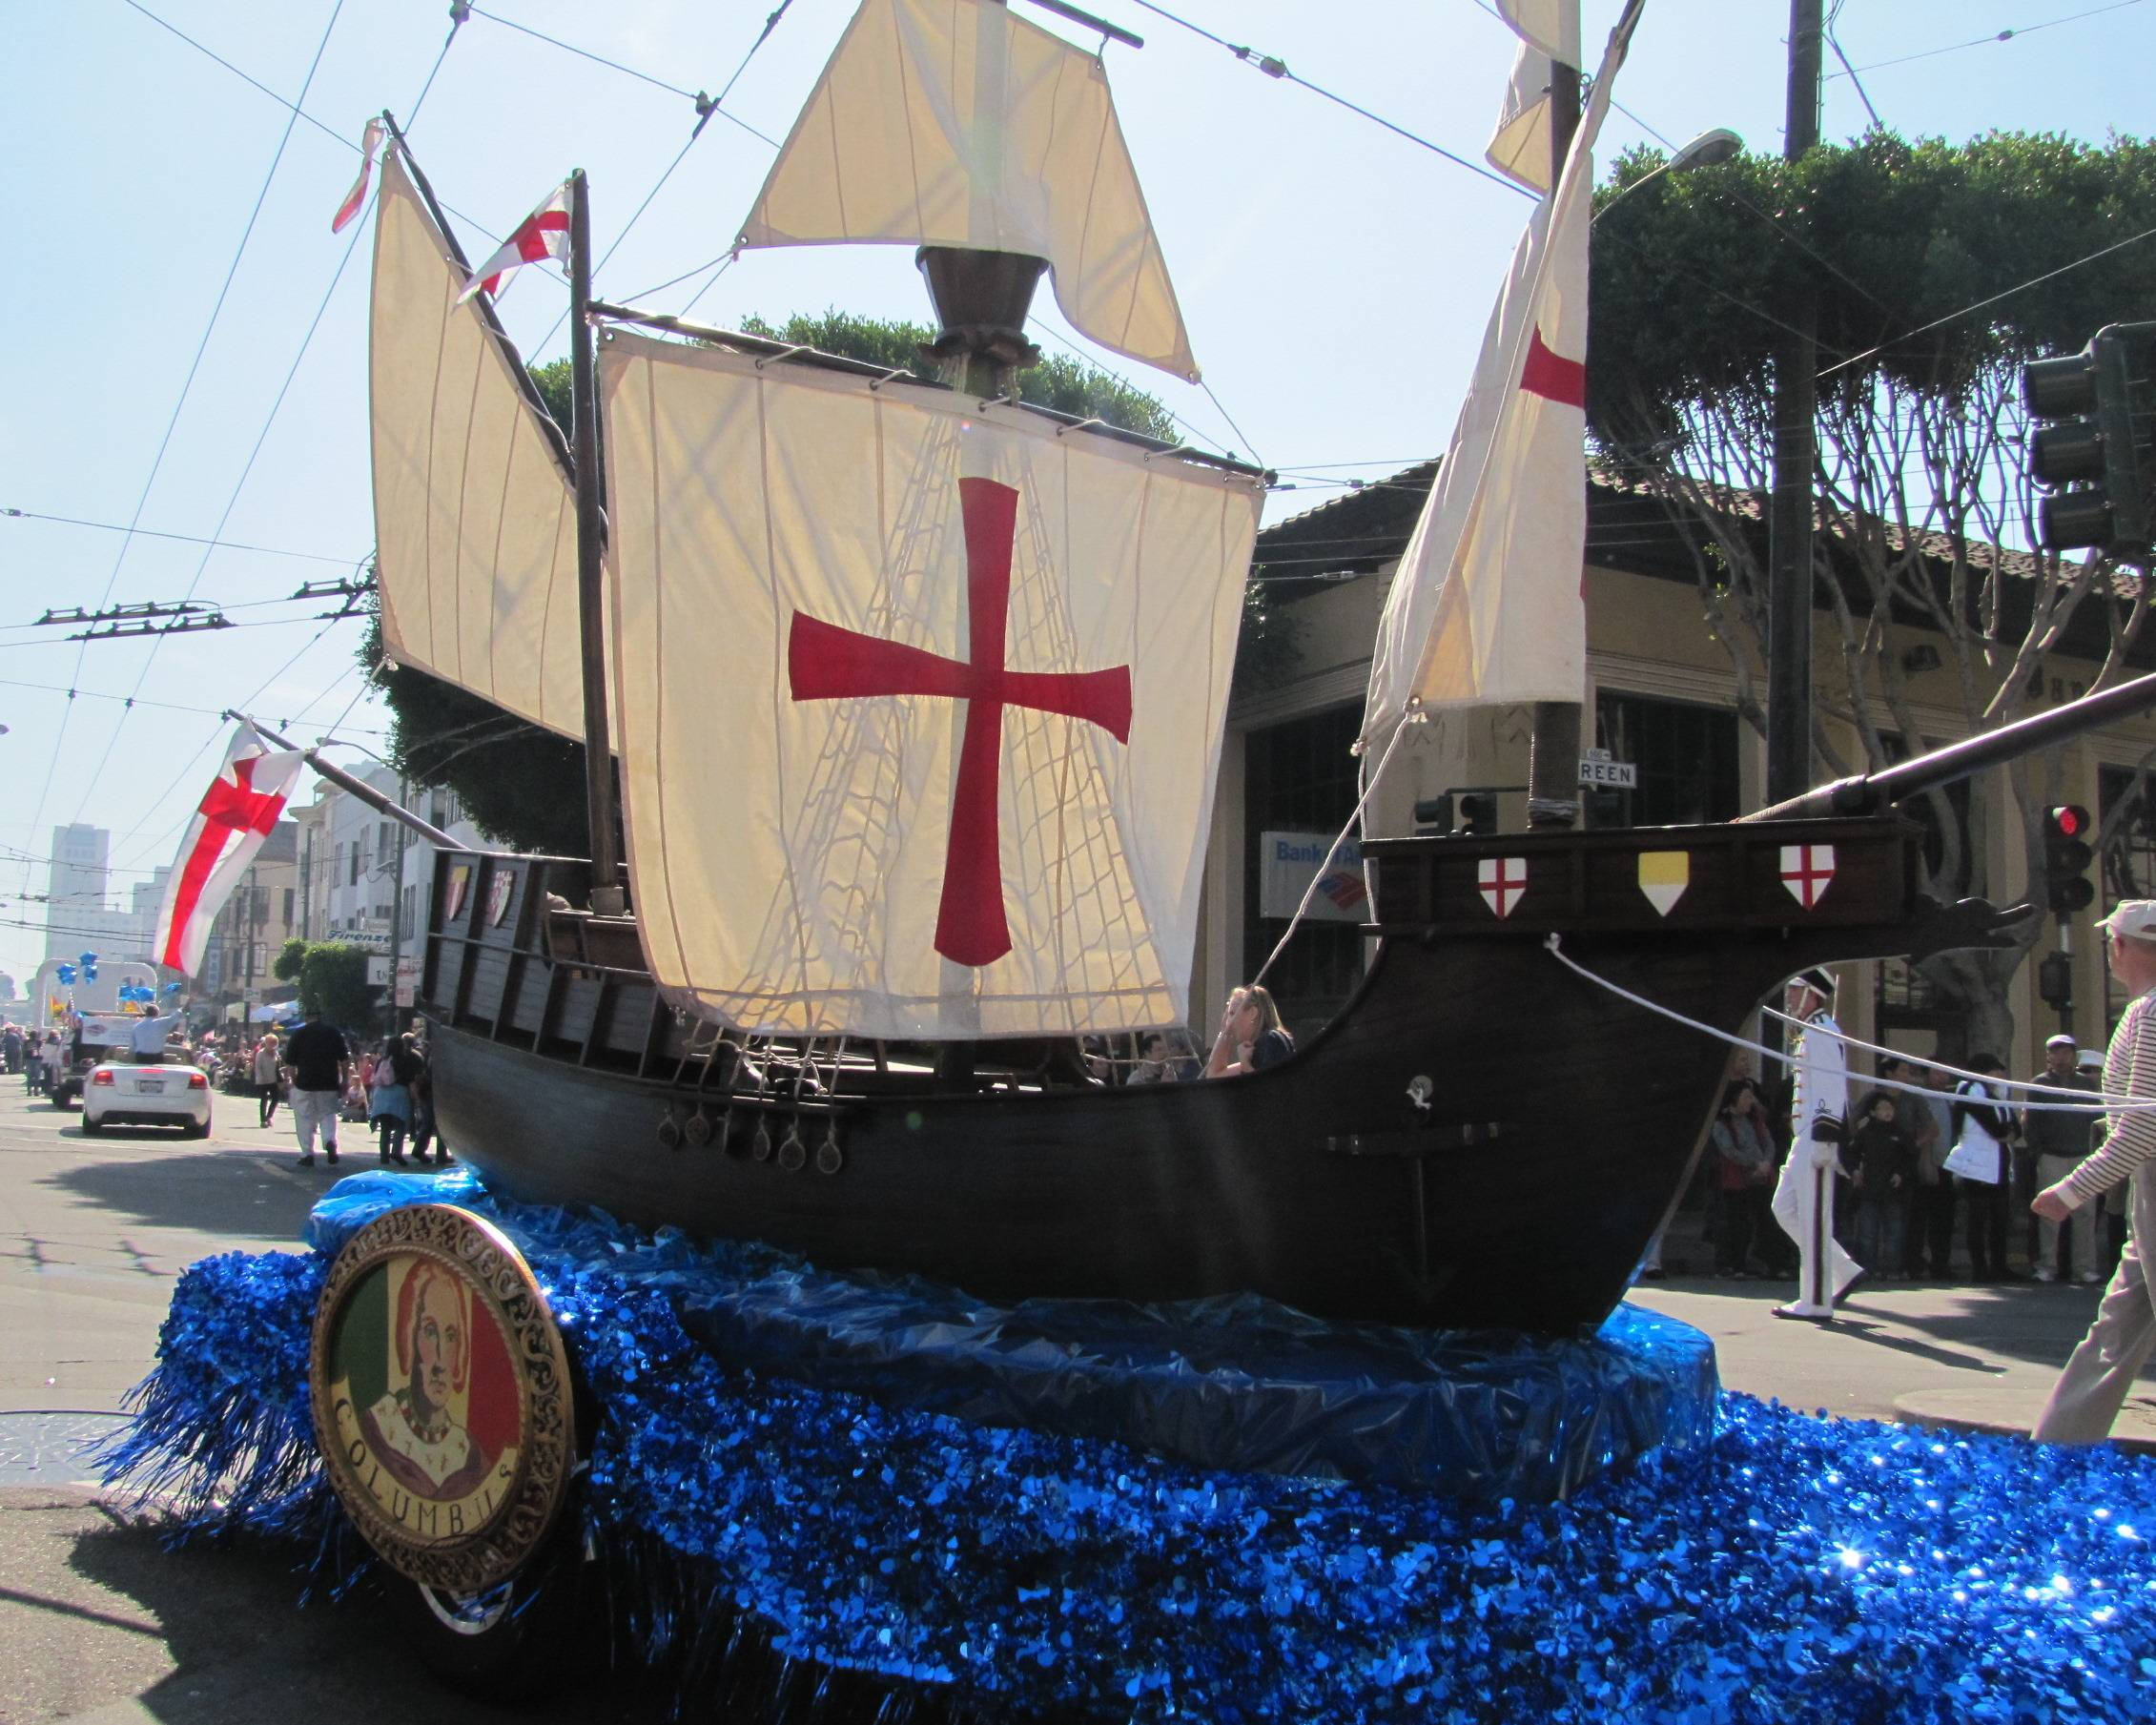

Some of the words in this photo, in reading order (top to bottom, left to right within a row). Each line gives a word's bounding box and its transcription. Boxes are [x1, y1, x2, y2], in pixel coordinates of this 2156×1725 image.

[1580, 763, 1632, 783] REEN
[1276, 840, 1322, 863] Bank
[327, 930, 392, 943] Firenze
[335, 1398, 512, 1535] COLUMBUS
